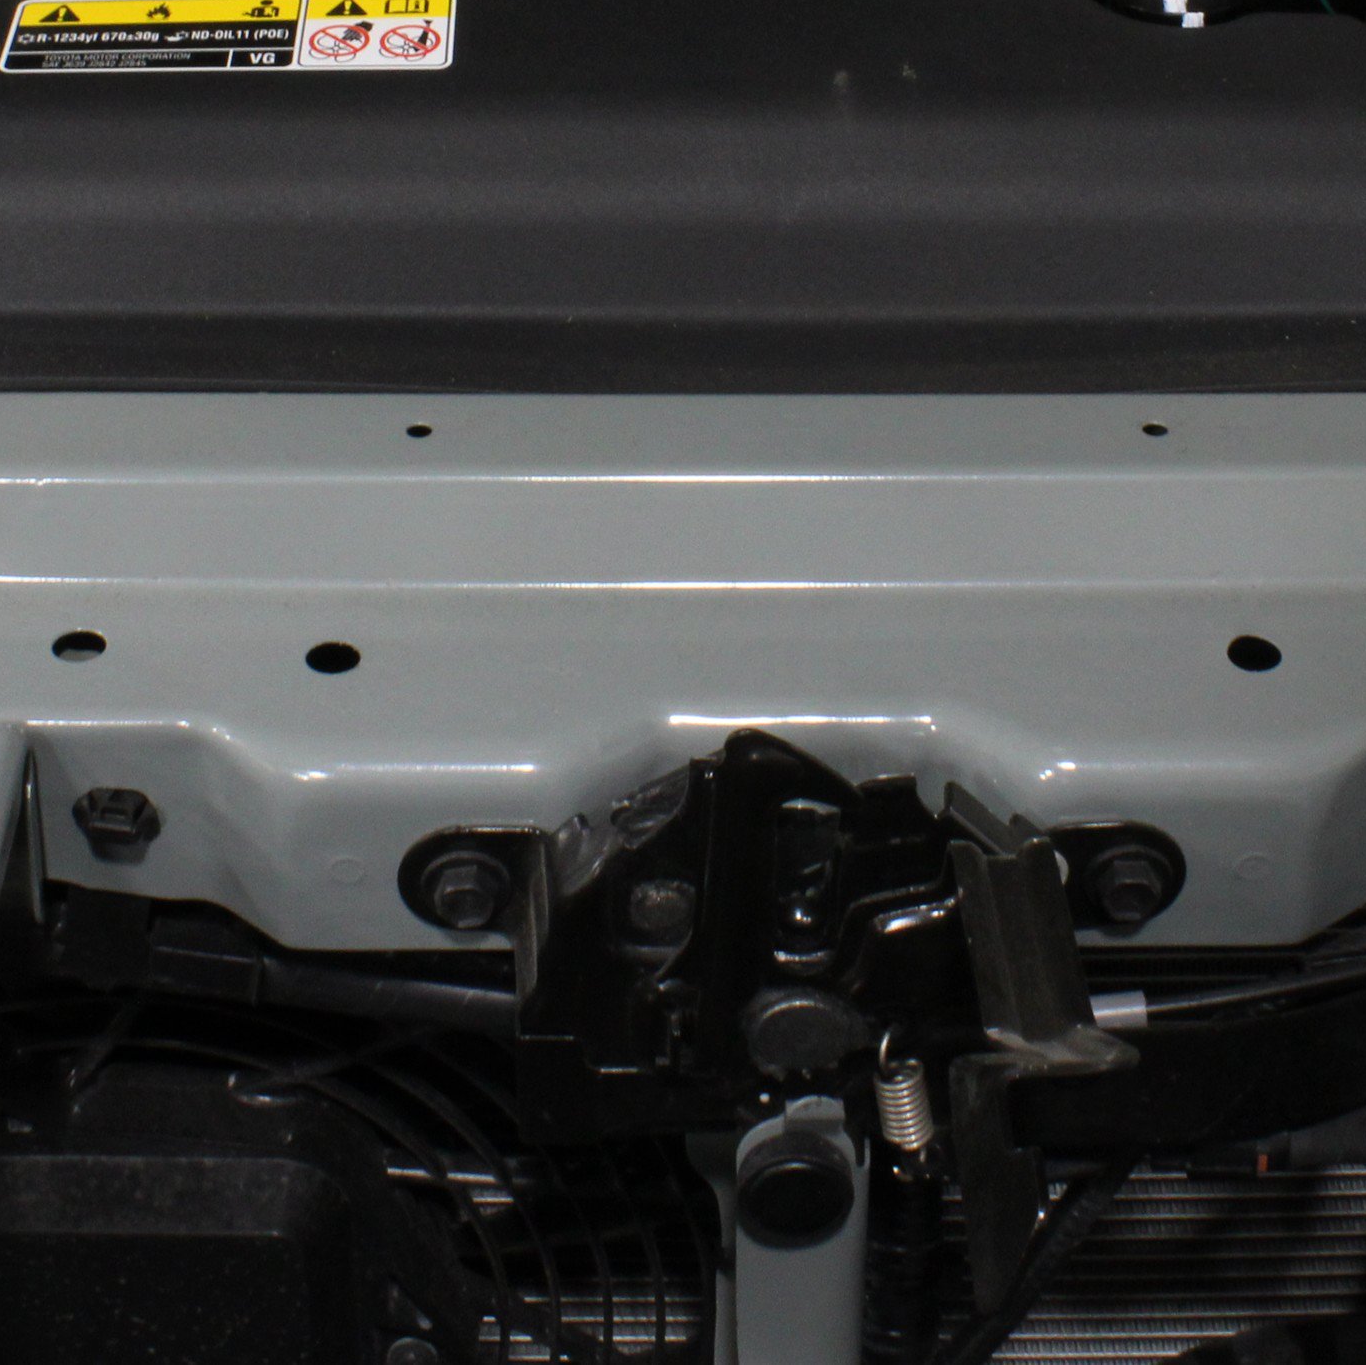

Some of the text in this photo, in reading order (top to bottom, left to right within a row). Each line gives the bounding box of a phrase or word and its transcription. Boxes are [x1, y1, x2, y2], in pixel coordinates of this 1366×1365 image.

[37, 30, 160, 44] R-1234yf 670±30g
[254, 28, 290, 41] (POE)
[44, 52, 191, 62] TOYOTA MOTOR CORPORATION
[249, 52, 276, 65] VG
